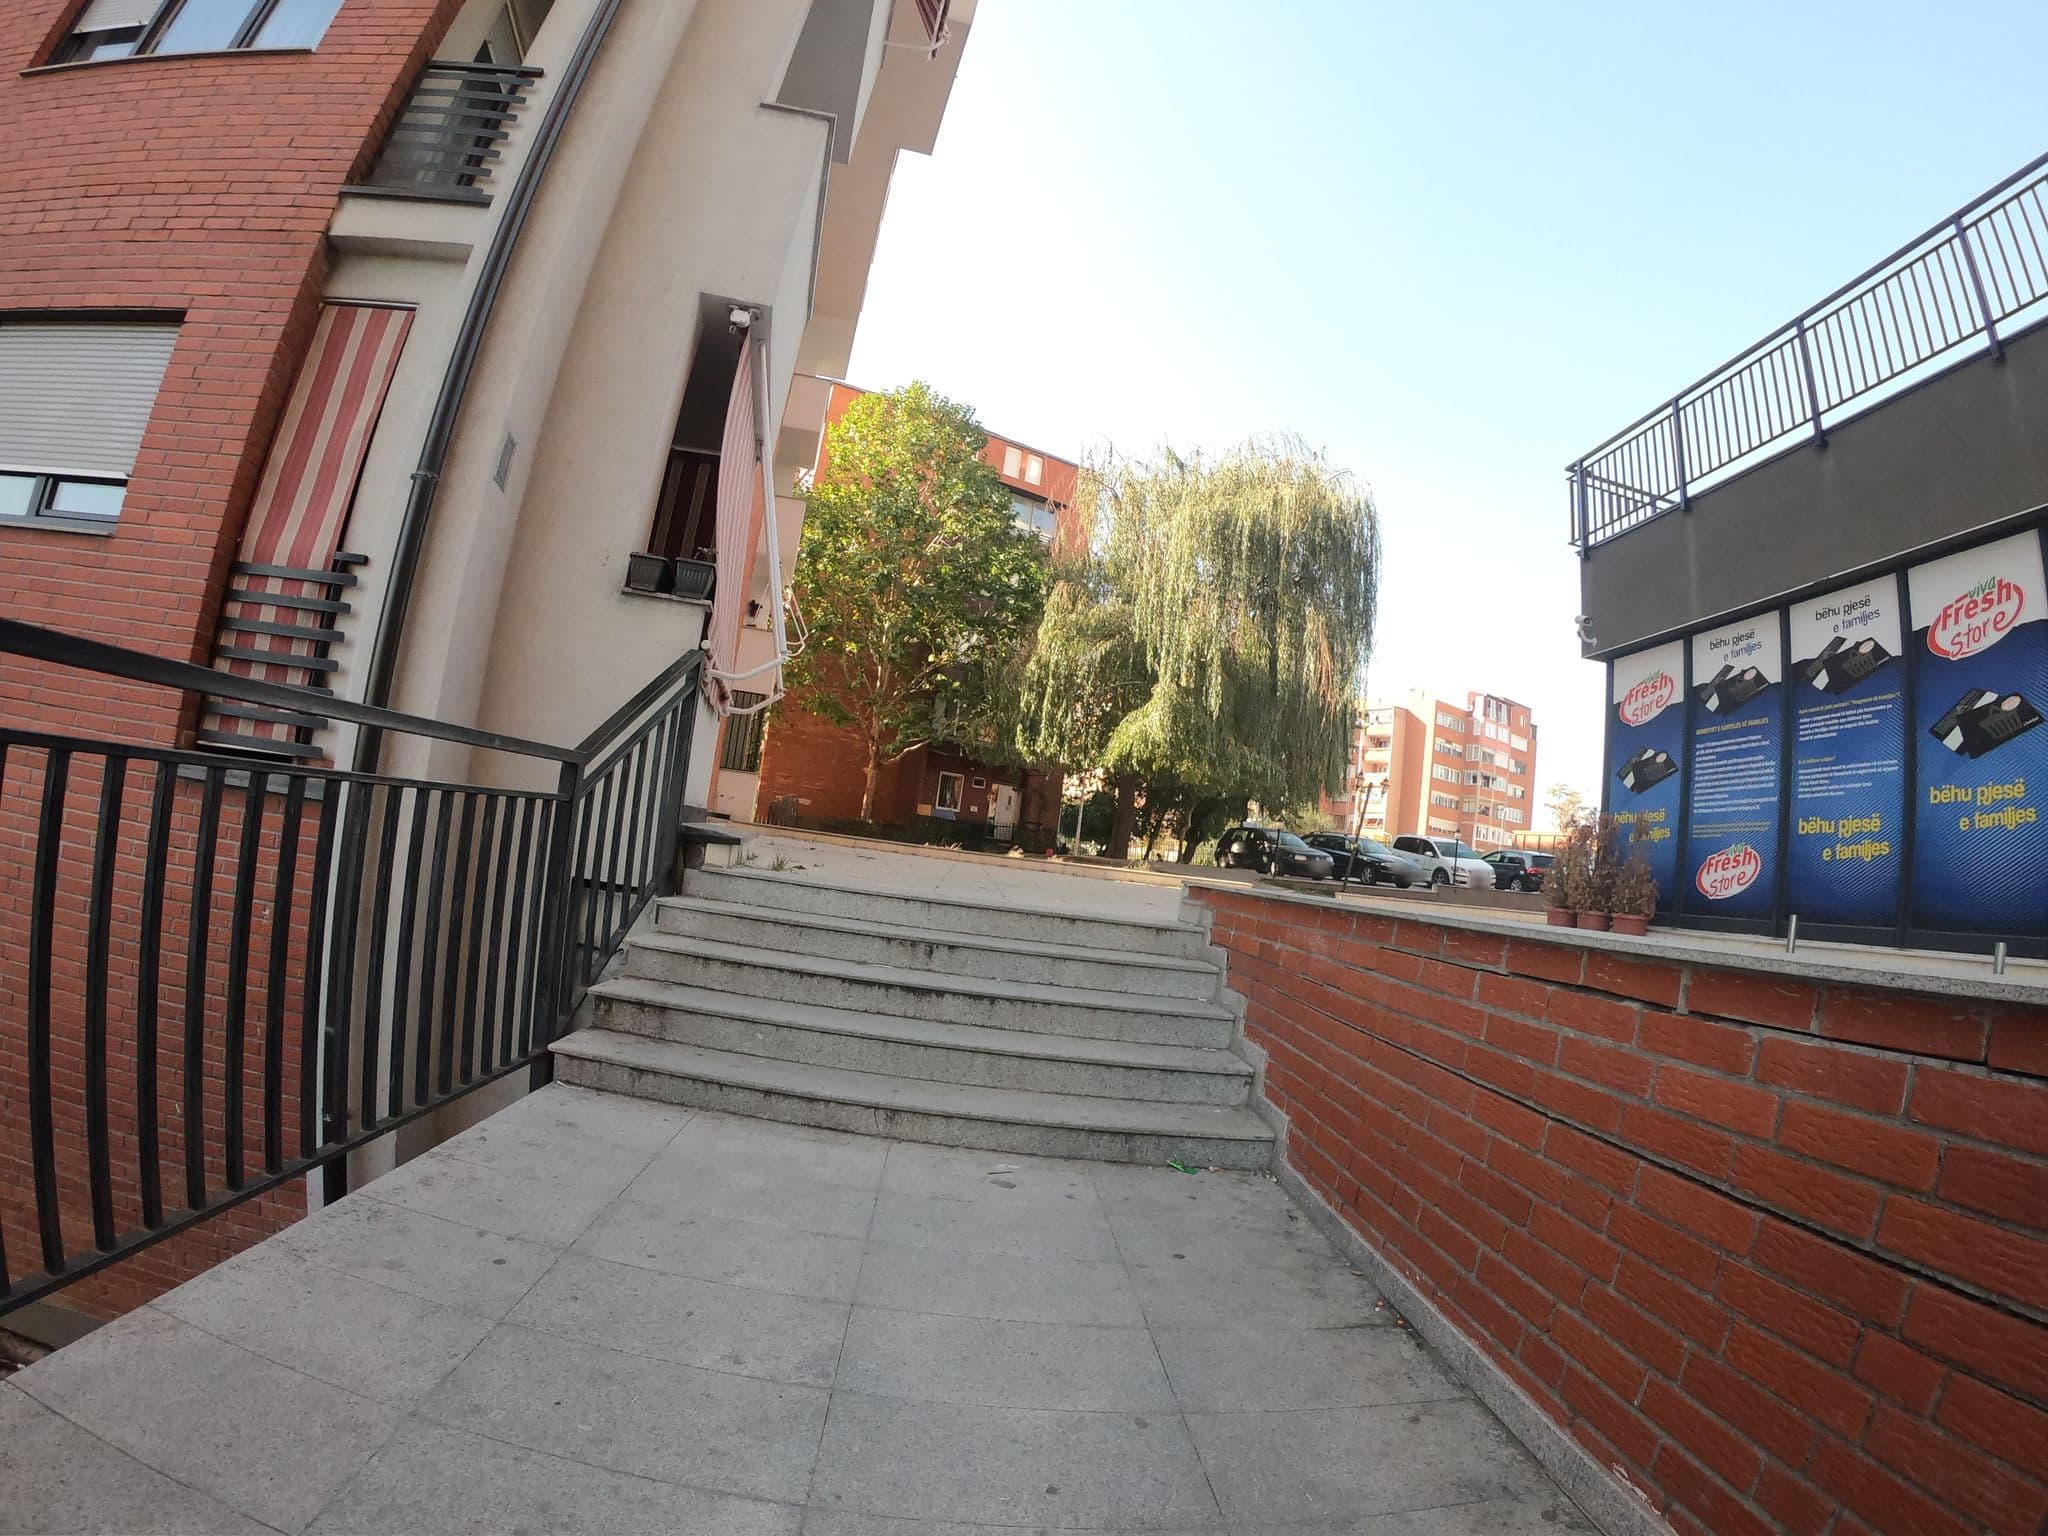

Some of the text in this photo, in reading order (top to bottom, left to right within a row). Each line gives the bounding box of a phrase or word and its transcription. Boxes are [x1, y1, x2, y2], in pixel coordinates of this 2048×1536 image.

[1968, 576, 1996, 599] viva
[1815, 594, 1871, 621] bëhu pjesë
[1941, 578, 2012, 631] Fresh
[1833, 608, 1880, 633] e familjes
[1709, 628, 1755, 650] bëhu pjesë
[1950, 610, 2006, 658] Store
[1723, 641, 1762, 662] e familjes
[1628, 672, 1669, 705] Fresh
[1632, 695, 1663, 724] Store
[1930, 777, 2025, 806] bëhu pjesë
[1798, 812, 1881, 838] bëhu pjesë
[1960, 806, 2036, 830] e familjes
[1706, 847, 1753, 875] Fresh
[1823, 839, 1889, 862] e familjes
[1710, 871, 1746, 896] Store
